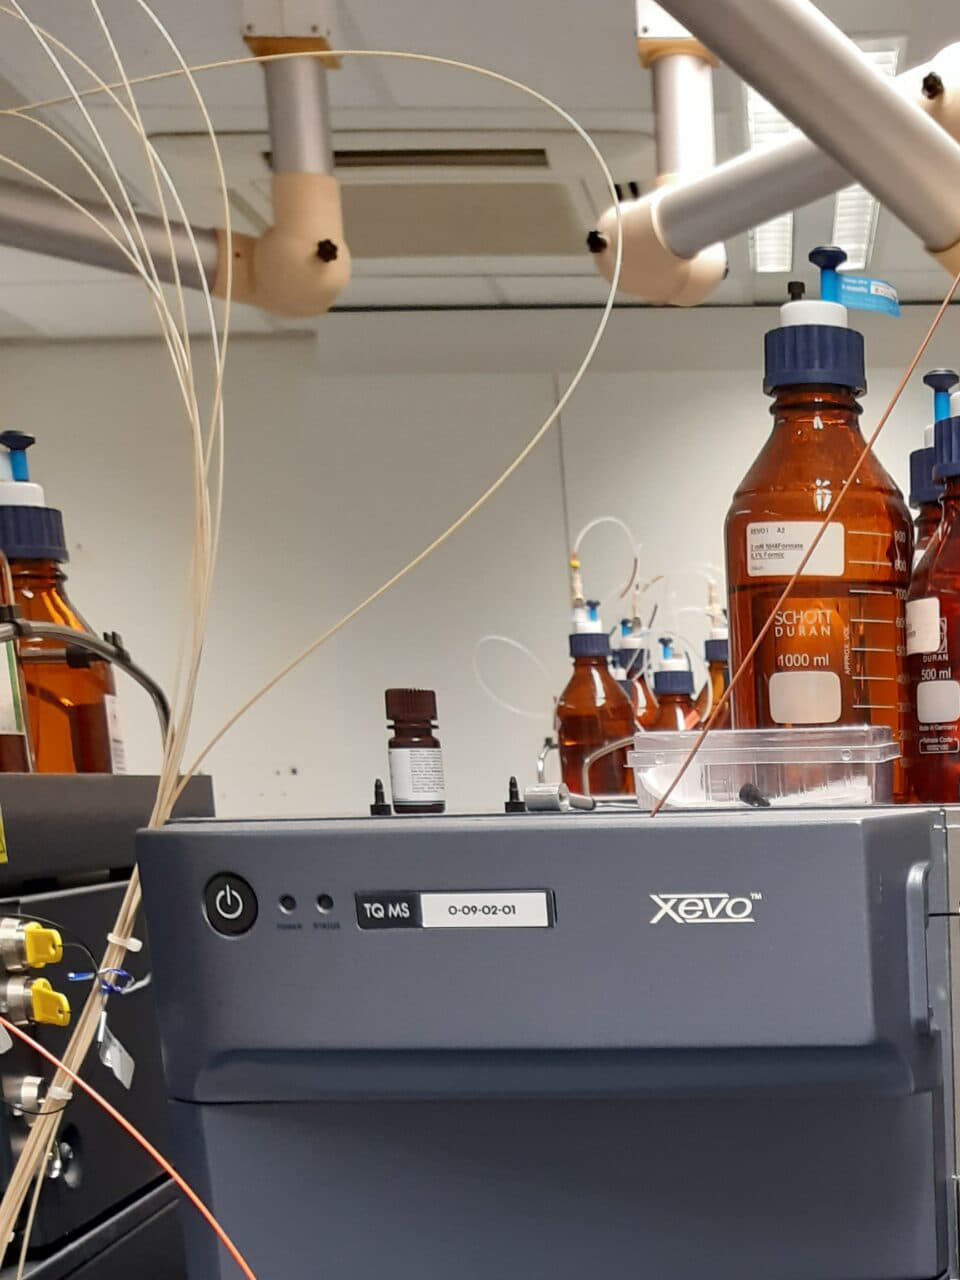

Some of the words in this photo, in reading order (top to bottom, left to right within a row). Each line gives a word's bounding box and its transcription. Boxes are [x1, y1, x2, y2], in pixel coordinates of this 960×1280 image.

[775, 609, 832, 625] SCHOTT
[775, 626, 831, 637] DURAN
[778, 653, 810, 667] 1000
[813, 652, 830, 666] ml
[922, 653, 949, 663] DURAN
[921, 668, 937, 681] 500
[938, 666, 952, 679] ml
[364, 902, 385, 919] TQ
[388, 901, 410, 918] MS
[448, 904, 517, 916] 0-09-02-01
